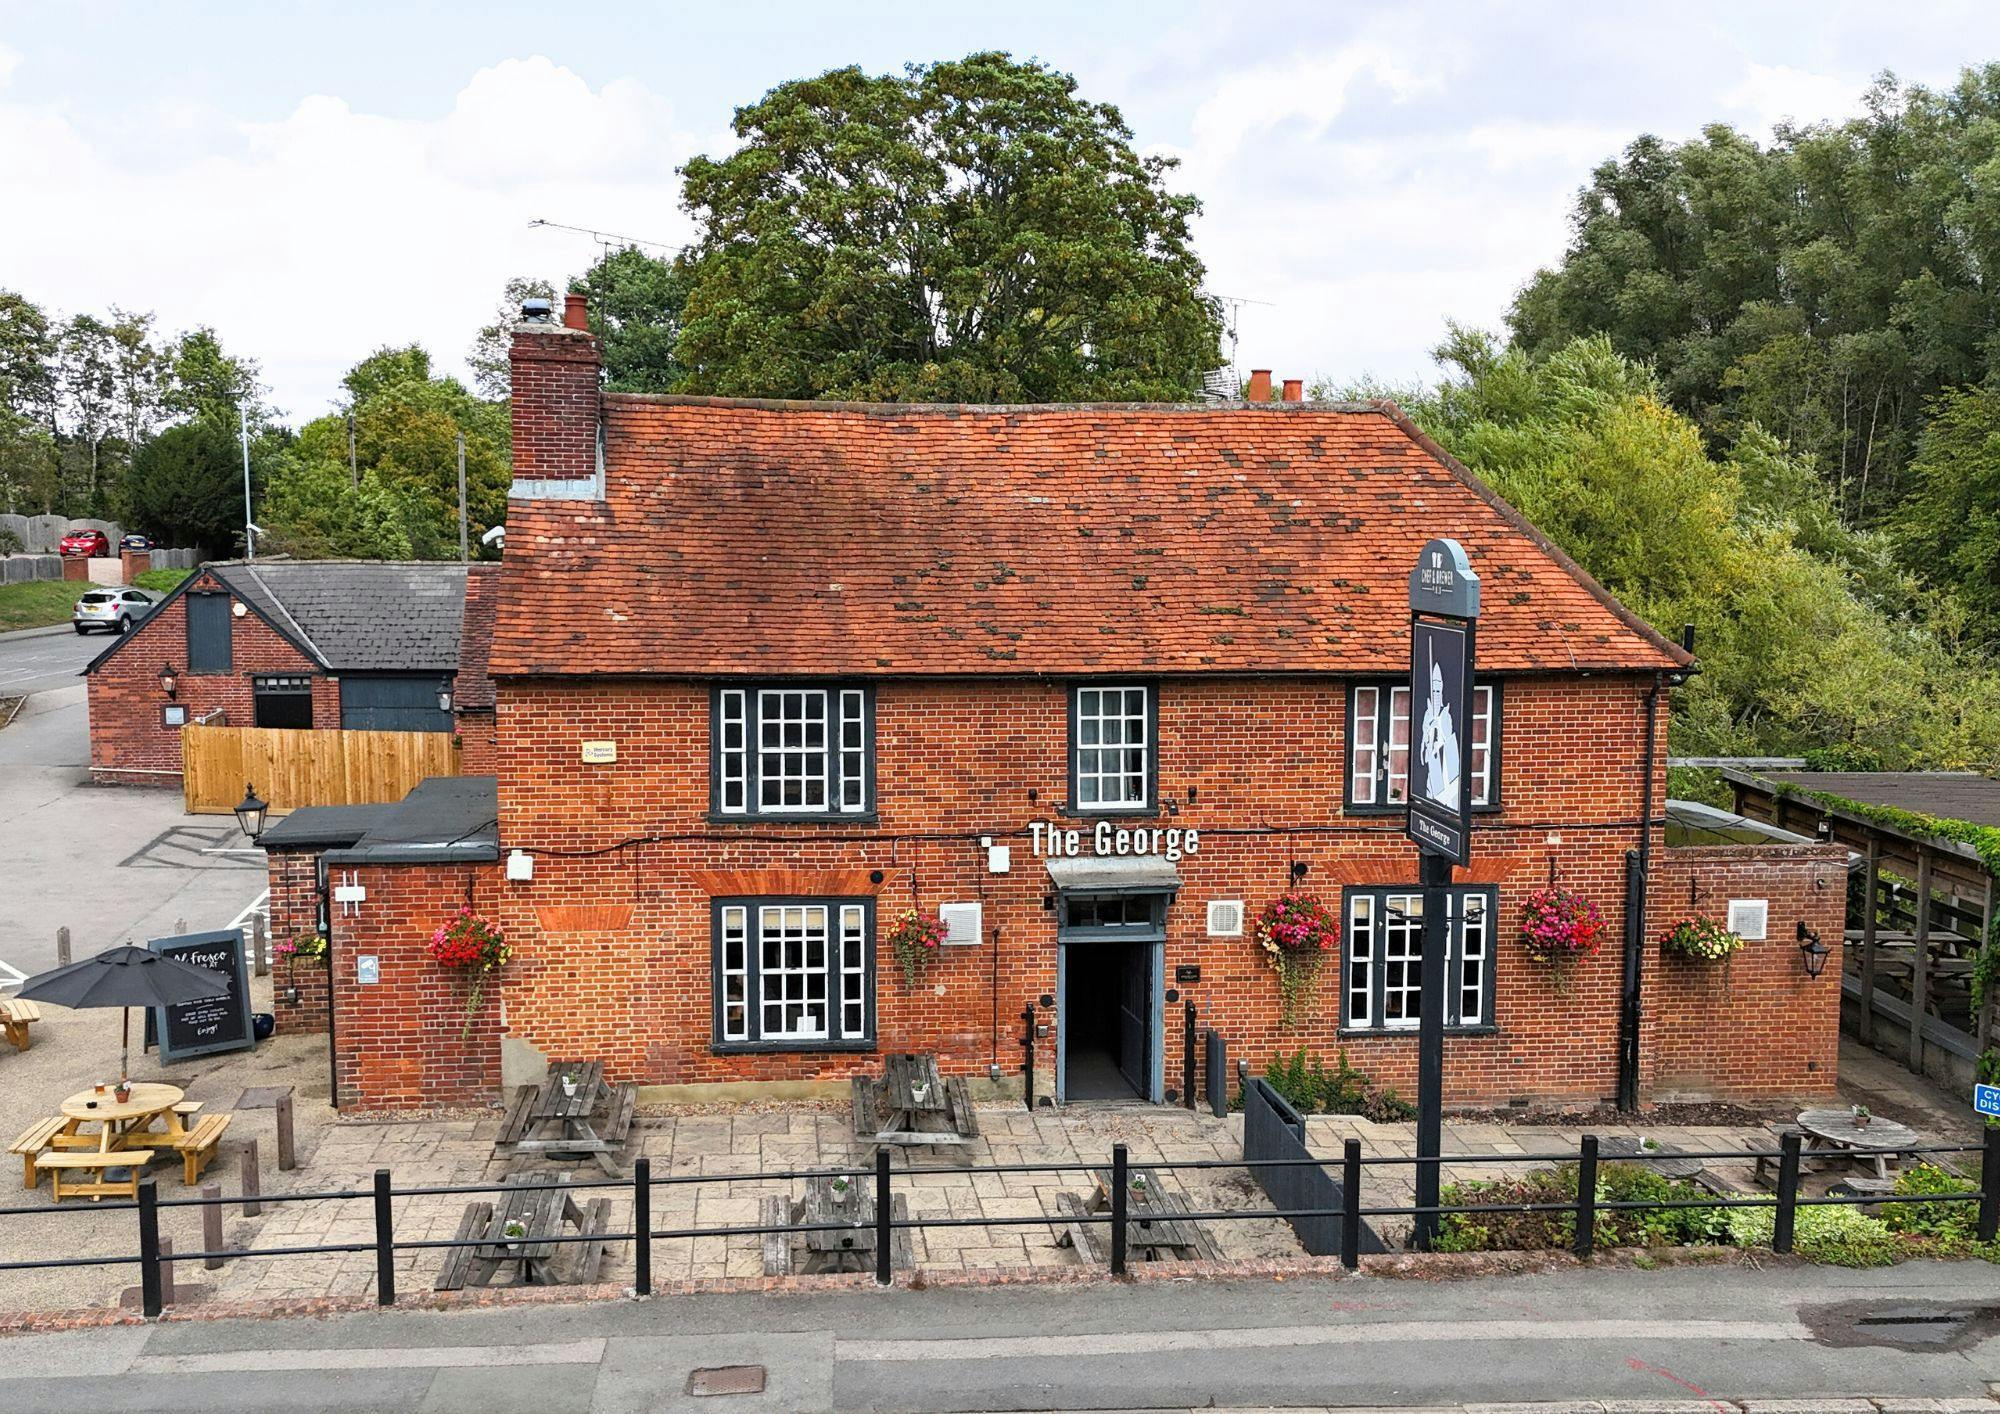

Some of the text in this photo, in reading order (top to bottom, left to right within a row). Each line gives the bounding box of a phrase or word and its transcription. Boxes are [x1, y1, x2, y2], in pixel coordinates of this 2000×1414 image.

[1028, 820, 1199, 861] The George
[1419, 819, 1450, 846] The George
